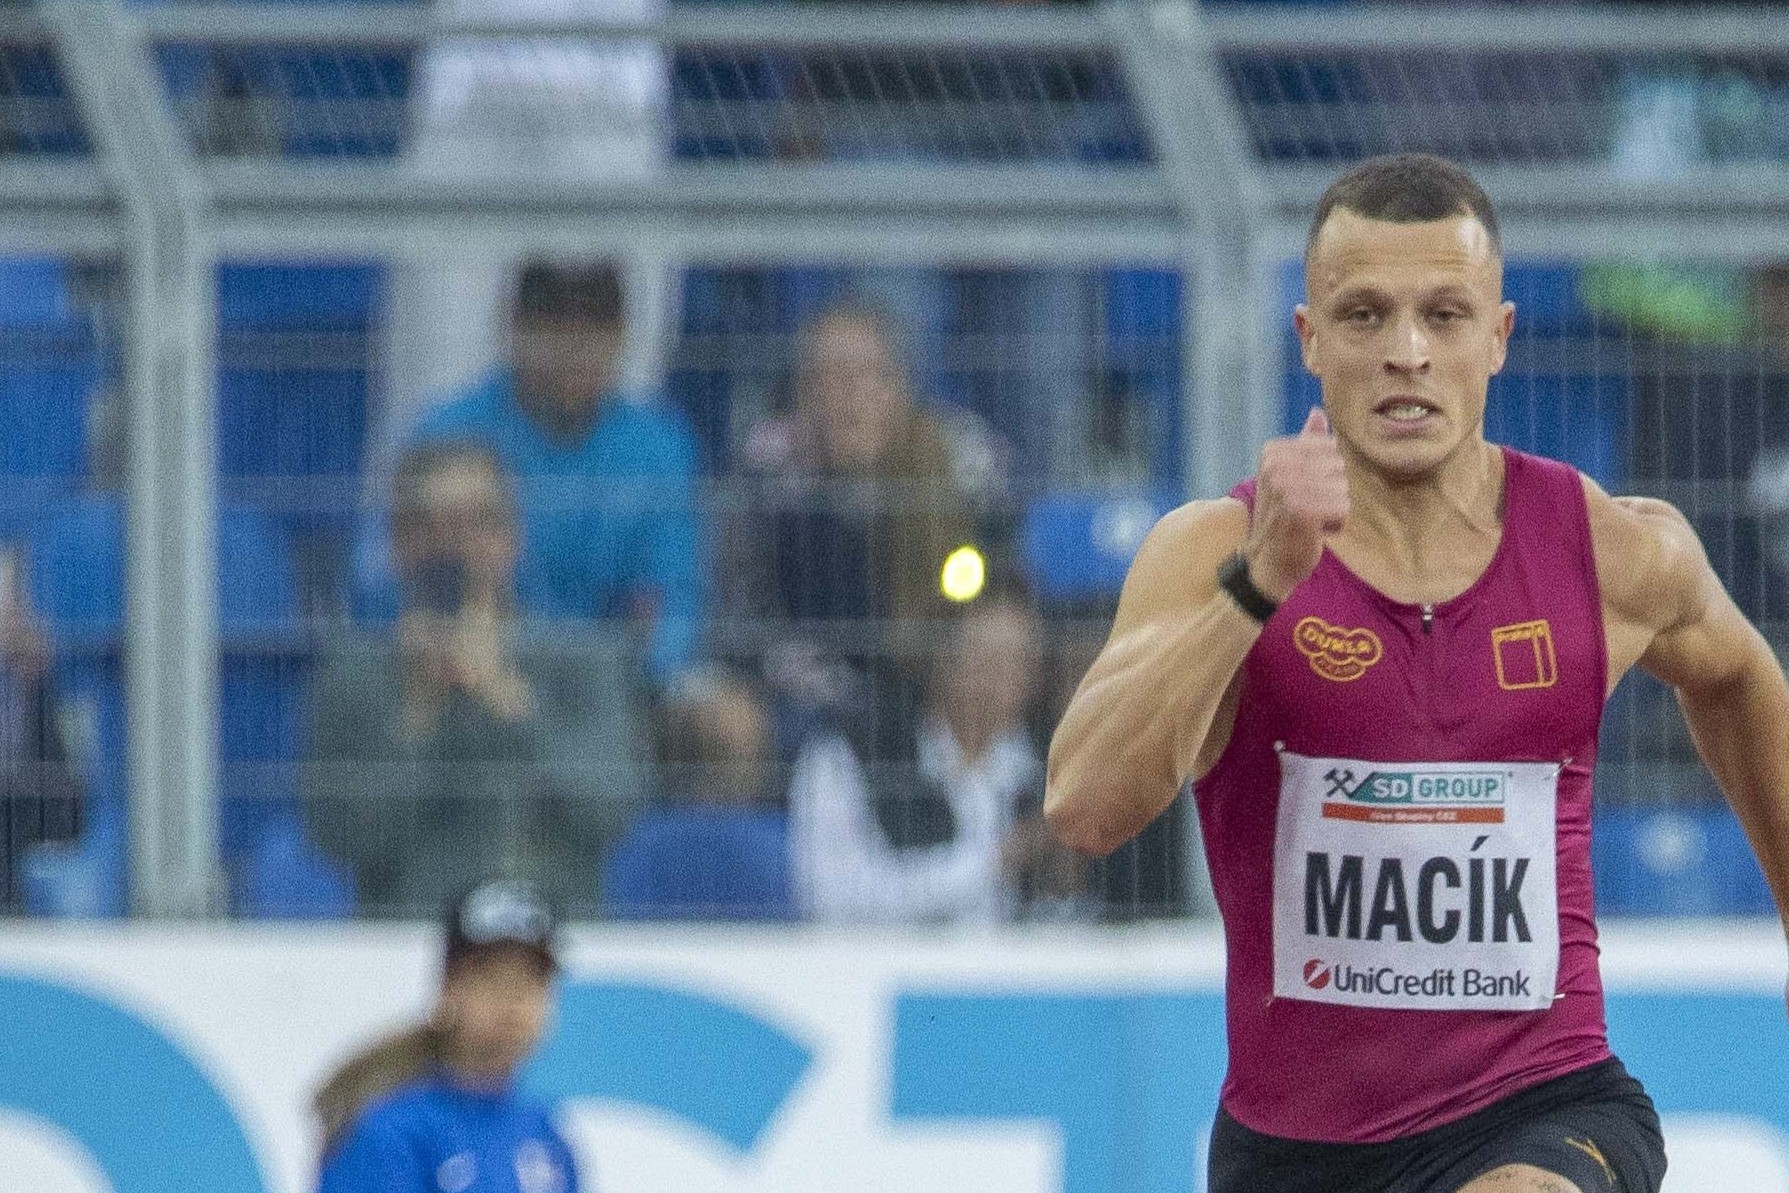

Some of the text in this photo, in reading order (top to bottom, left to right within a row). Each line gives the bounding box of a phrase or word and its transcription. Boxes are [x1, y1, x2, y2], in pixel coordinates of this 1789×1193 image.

[1370, 777, 1499, 799] SD GROUP
[1303, 835, 1532, 944] MACÍK
[1334, 963, 1531, 998] UniCredit Bank
